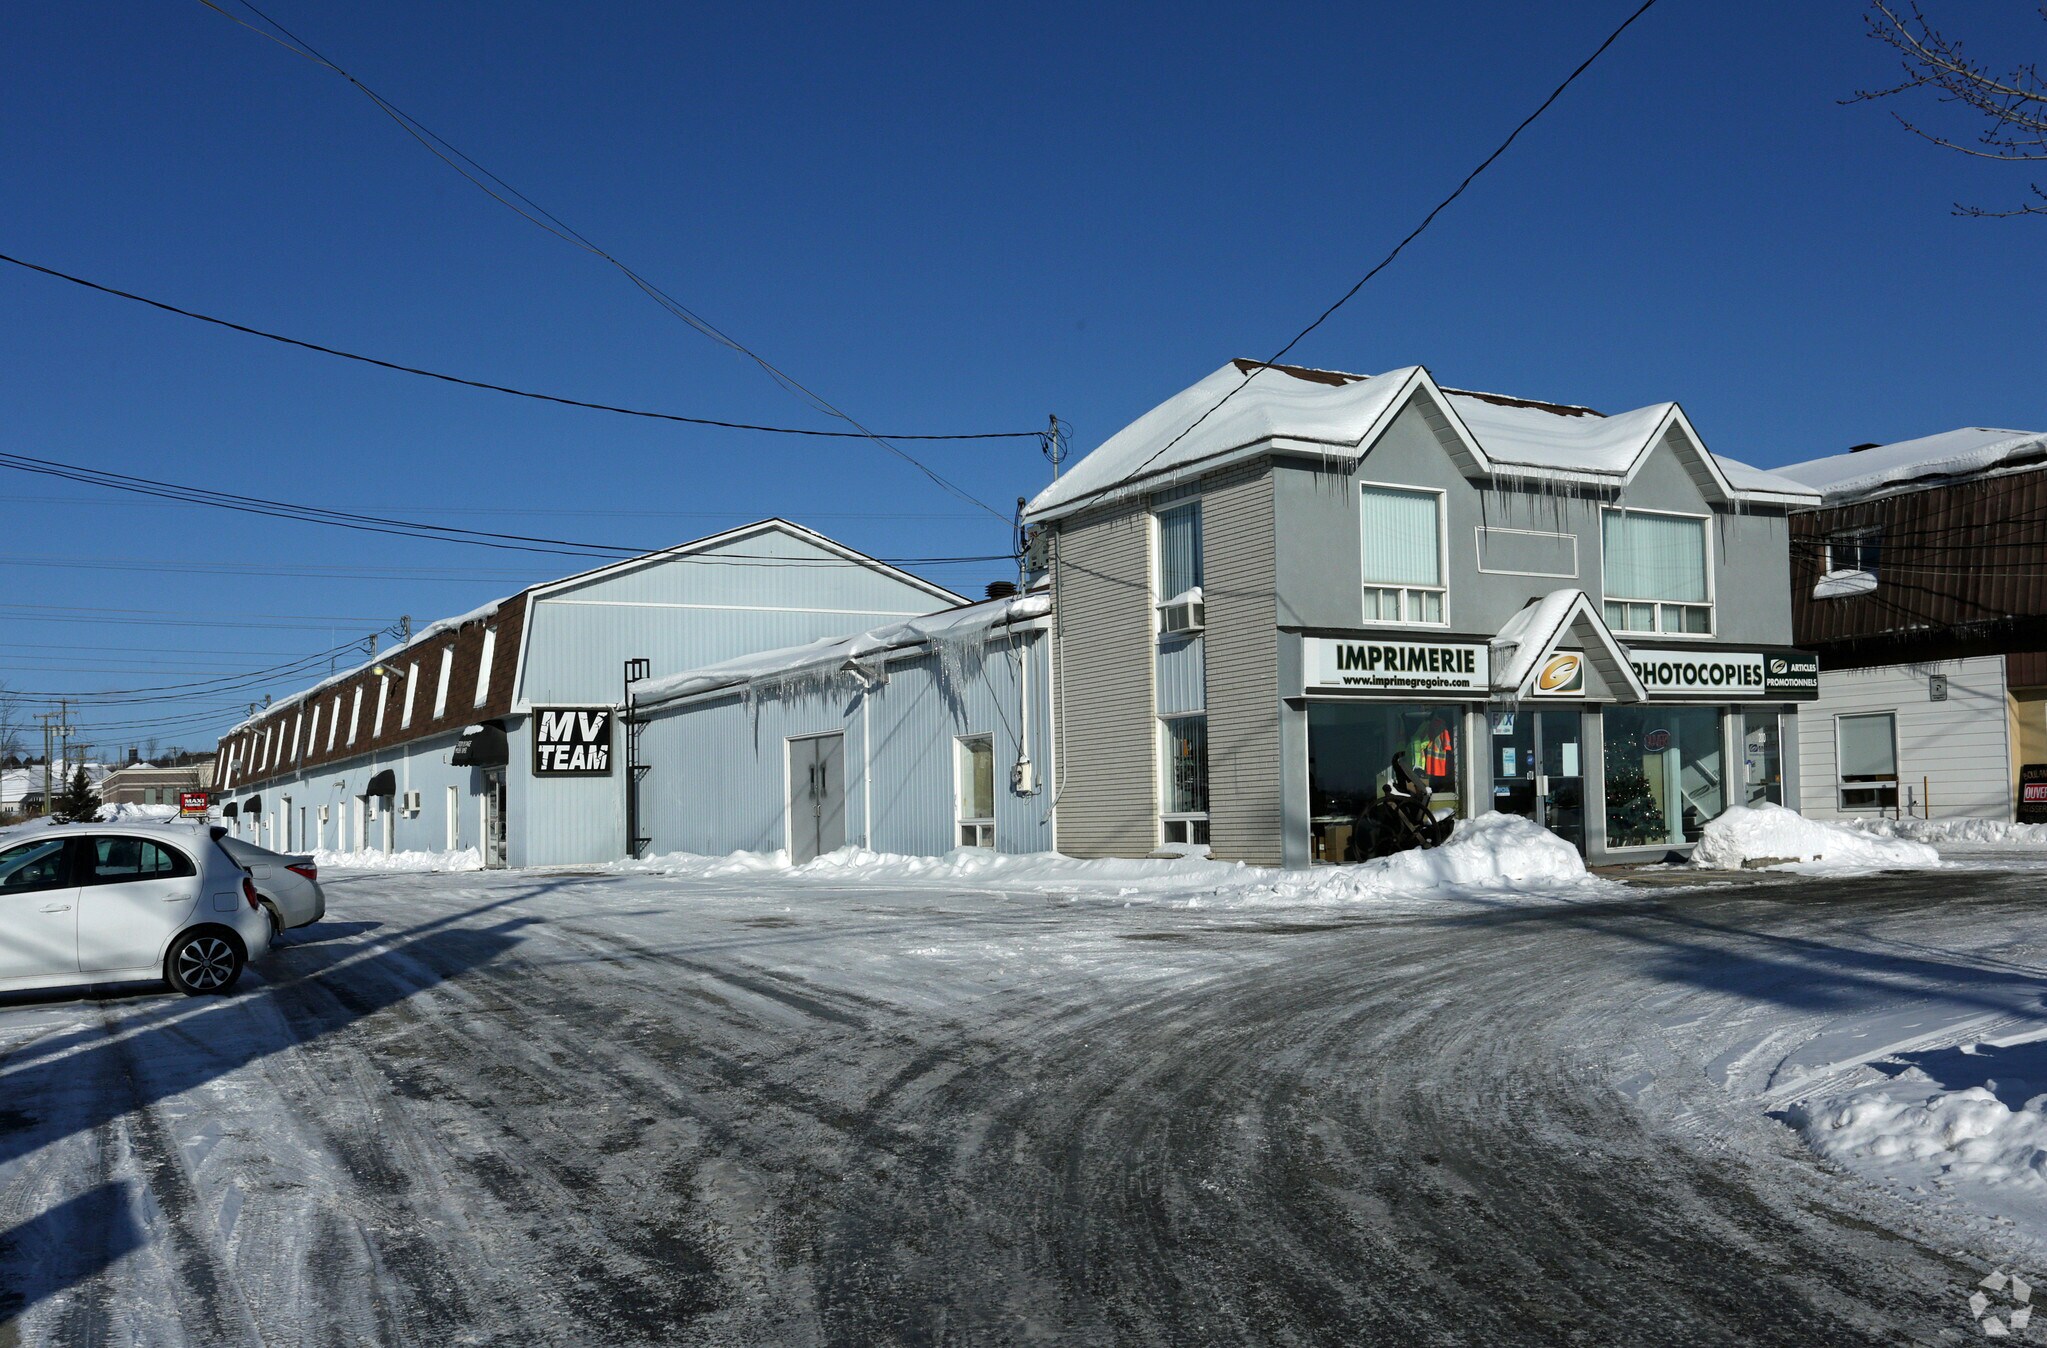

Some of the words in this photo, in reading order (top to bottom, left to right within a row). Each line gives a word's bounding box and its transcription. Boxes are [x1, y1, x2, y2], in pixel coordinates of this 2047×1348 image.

[1336, 644, 1475, 673] IMPRIMERIE
[1790, 663, 1816, 672] ARTICLES
[1342, 675, 1470, 688] www.imprimegregoire.com
[1631, 662, 1763, 686] PHOTOCOPIES
[1766, 678, 1817, 687] PROMOTIONNELS
[538, 711, 608, 742] MV
[538, 745, 608, 770] TEAM
[2025, 786, 2047, 799] OUVE
